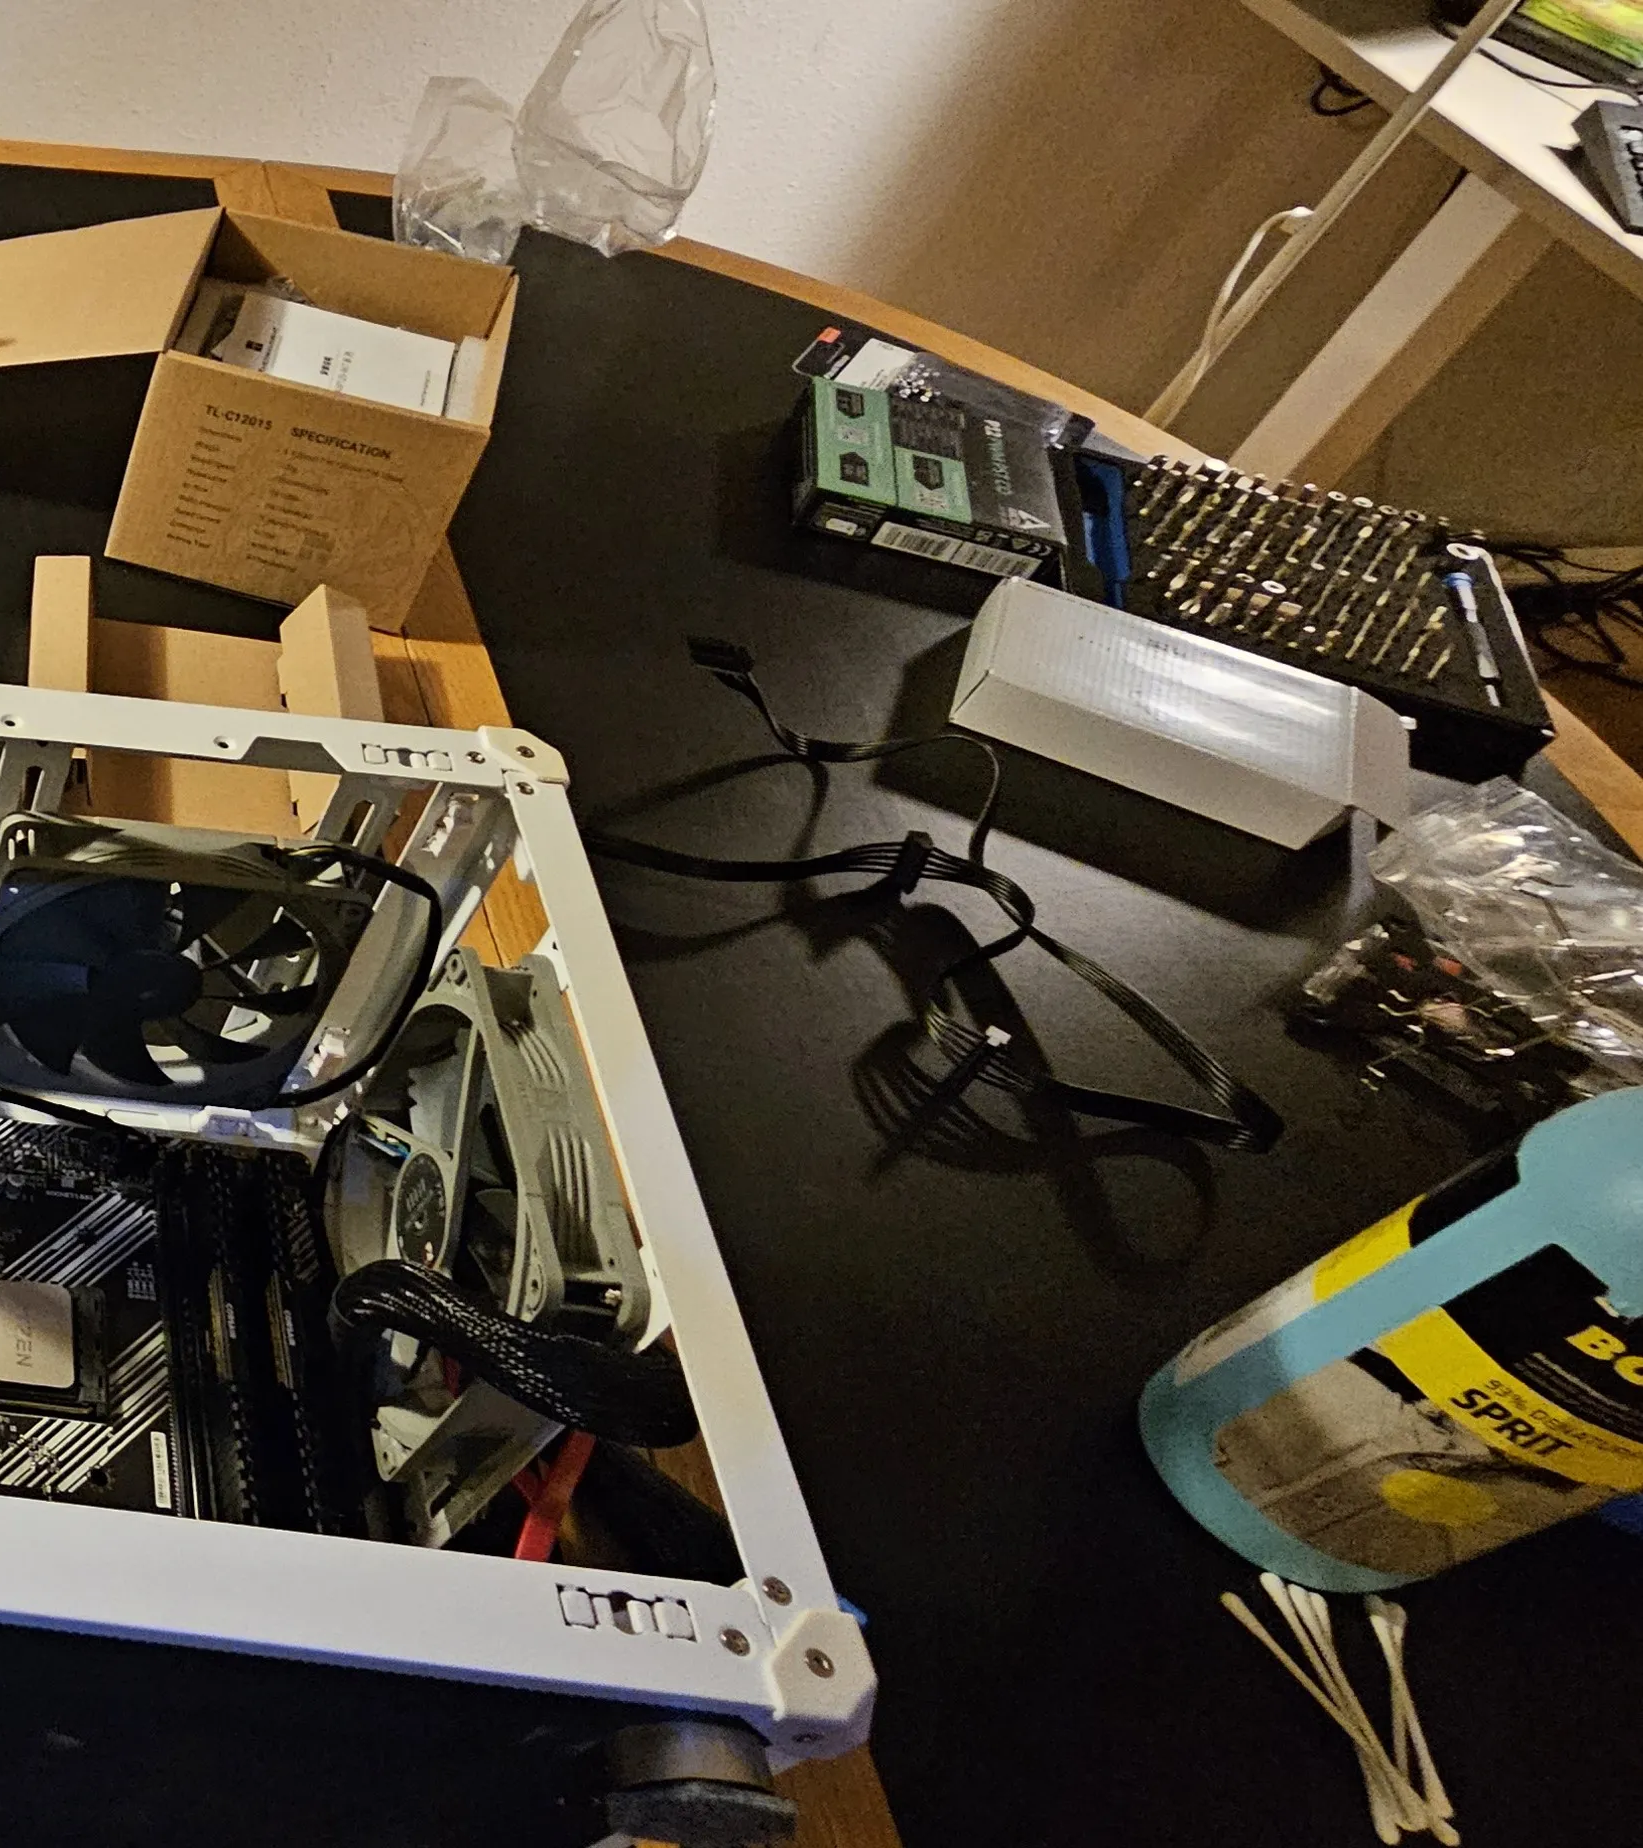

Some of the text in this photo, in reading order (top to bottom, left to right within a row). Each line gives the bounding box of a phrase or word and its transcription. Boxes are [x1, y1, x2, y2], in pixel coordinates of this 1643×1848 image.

[206, 404, 392, 460] TL-C12015 SPECIFICATION
[1450, 1388, 1574, 1456] SPRIT
